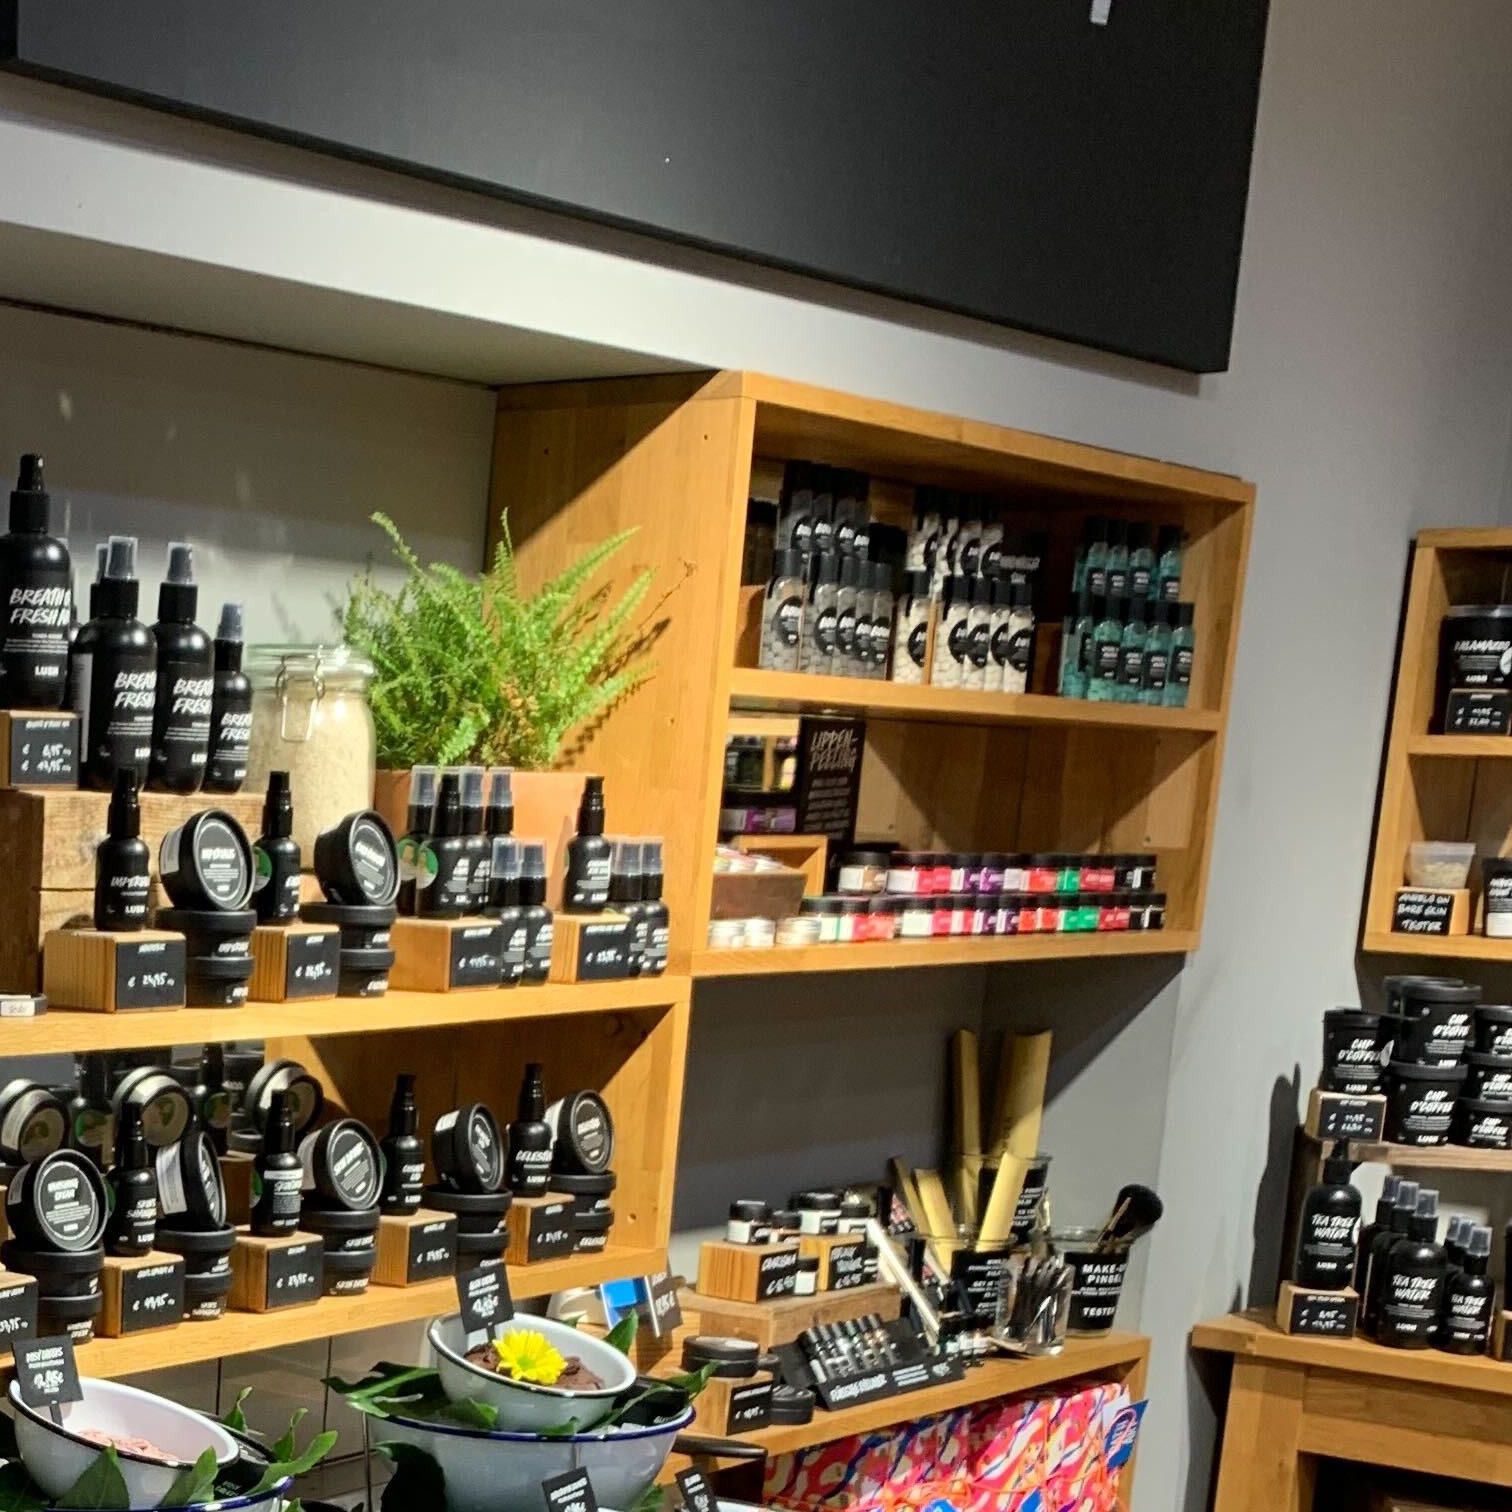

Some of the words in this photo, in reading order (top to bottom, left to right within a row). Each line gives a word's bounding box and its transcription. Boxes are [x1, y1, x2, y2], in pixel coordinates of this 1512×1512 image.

[11, 606, 58, 624] FRESH
[35, 666, 59, 676] LUSH
[124, 905, 146, 914] LUSH
[1401, 919, 1442, 931] TESTER
[1447, 1013, 1469, 1025] CUP
[1350, 1038, 1376, 1050] CUP
[1345, 1083, 1368, 1092] LUSH
[1424, 1089, 1449, 1101] CUP
[1409, 1100, 1456, 1113] O'COFFEE
[1417, 1134, 1440, 1143] LUSH
[1312, 1213, 1329, 1227] TEA
[1329, 1215, 1355, 1228] TREE
[1313, 1226, 1351, 1239] WATER
[1316, 1261, 1337, 1270] LUSH
[1392, 1274, 1410, 1288] TEA
[1410, 1276, 1438, 1289] TREE
[1394, 1287, 1432, 1302] WATER
[1451, 1293, 1464, 1304] TEA
[1464, 1295, 1487, 1307] TREE
[1395, 1322, 1417, 1332] LUSH
